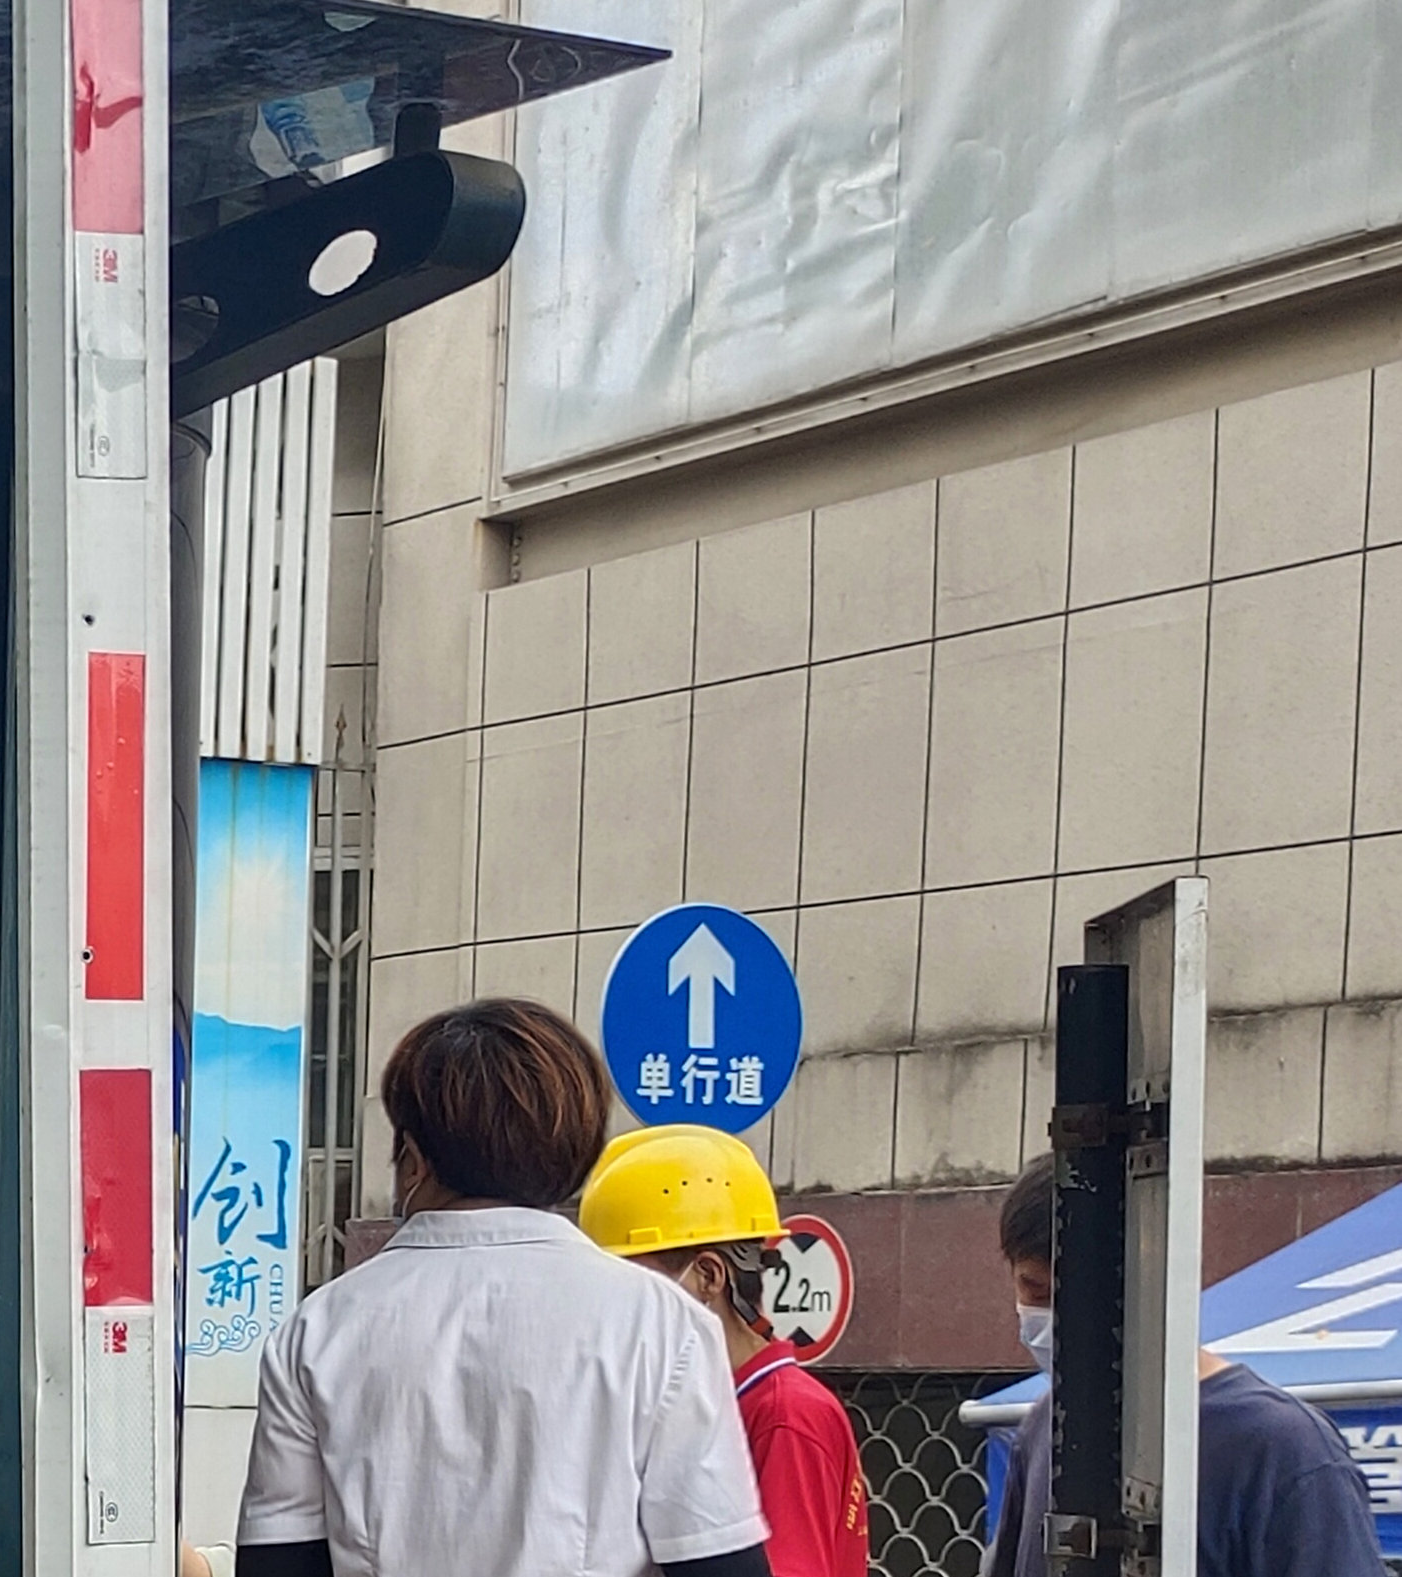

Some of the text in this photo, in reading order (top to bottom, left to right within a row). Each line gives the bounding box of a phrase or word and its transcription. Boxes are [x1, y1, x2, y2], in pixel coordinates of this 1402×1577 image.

[635, 1053, 765, 1107] 单行道
[192, 1136, 292, 1318] 创新
[773, 1263, 832, 1315] 2.2m
[112, 1321, 128, 1353] 3M
